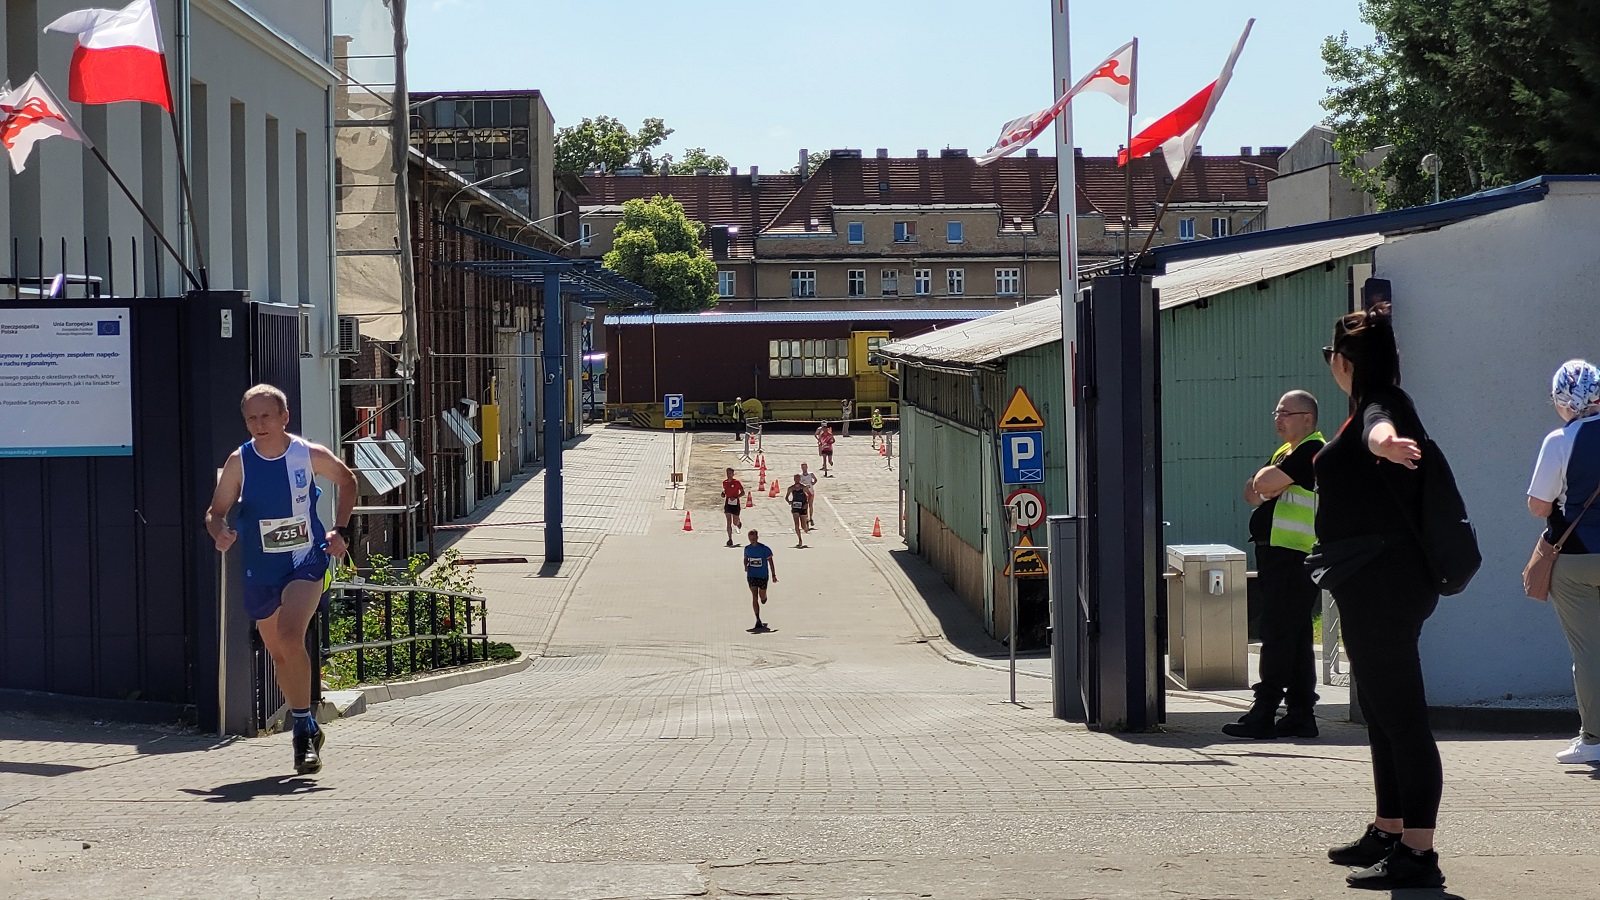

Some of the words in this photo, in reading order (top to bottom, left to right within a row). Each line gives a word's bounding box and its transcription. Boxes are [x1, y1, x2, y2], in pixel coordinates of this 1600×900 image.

[669, 396, 680, 411] P
[1011, 437, 1034, 468] P
[1015, 501, 1037, 519] 10
[275, 529, 297, 540] 735
